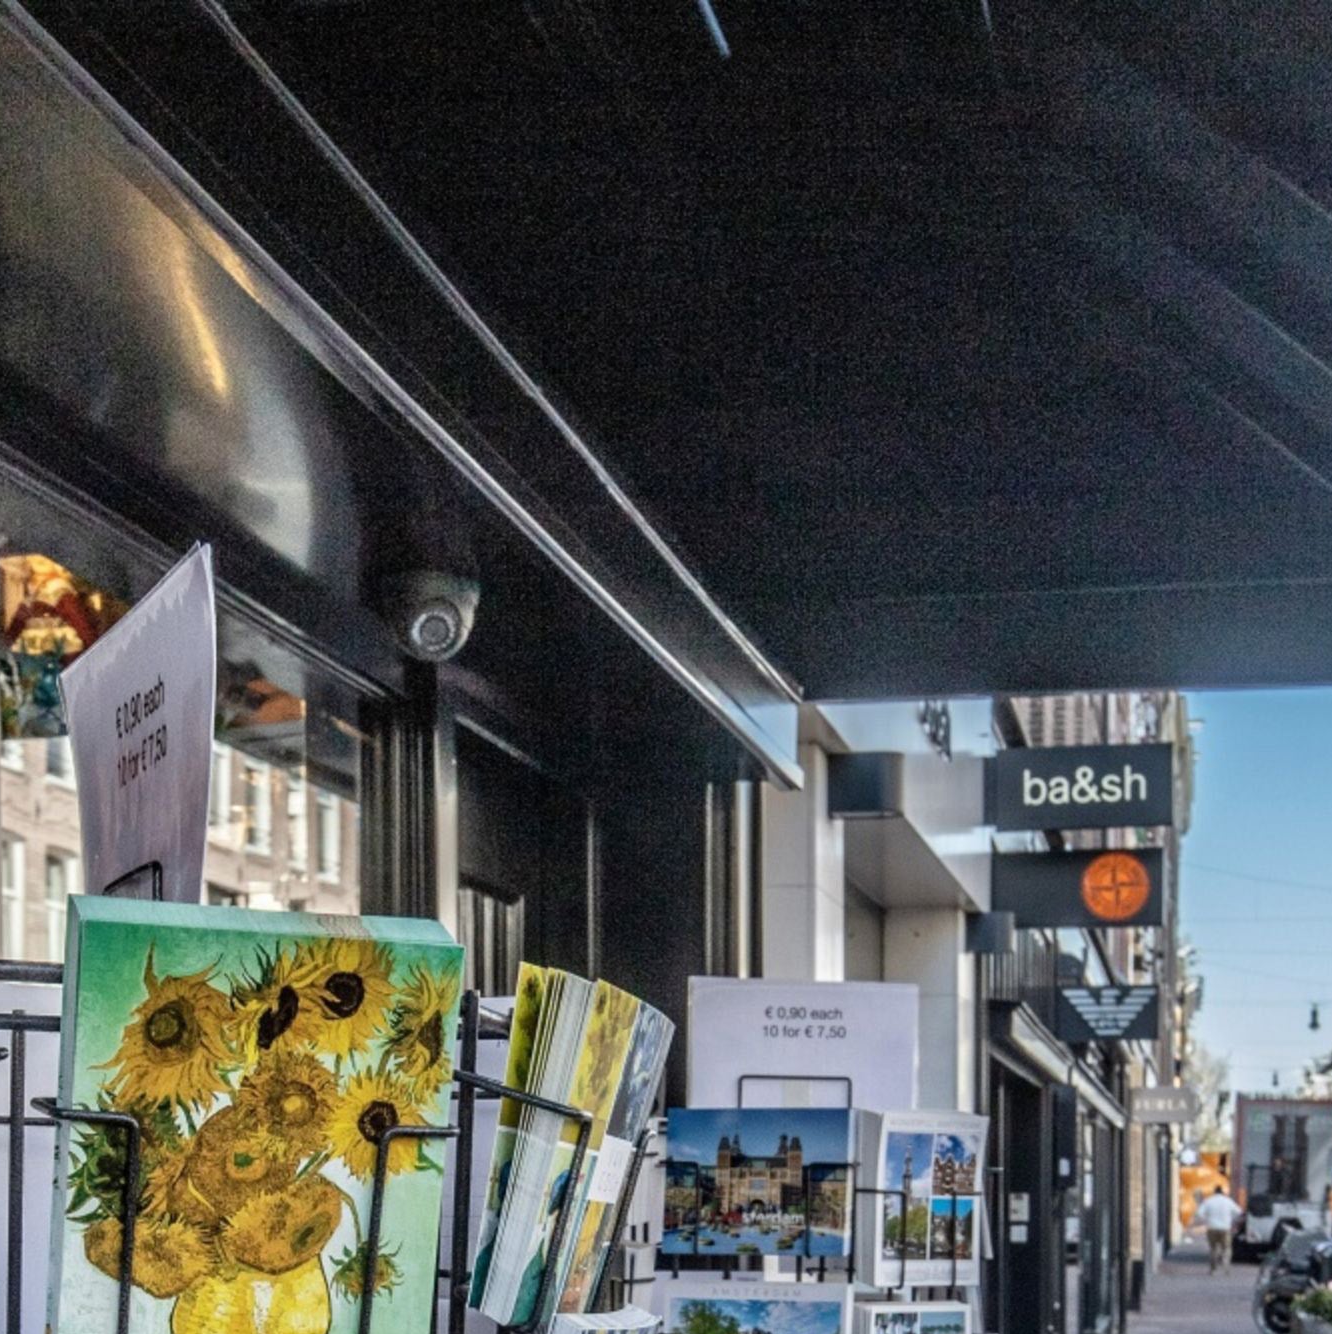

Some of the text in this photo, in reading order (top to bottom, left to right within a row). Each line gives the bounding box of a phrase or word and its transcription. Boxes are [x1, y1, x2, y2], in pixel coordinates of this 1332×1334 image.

[143, 674, 165, 718] each
[1022, 764, 1148, 806] ba&sh
[764, 1006, 844, 1020] € 0,90 each
[763, 1024, 847, 1041] 10 for € 7,50
